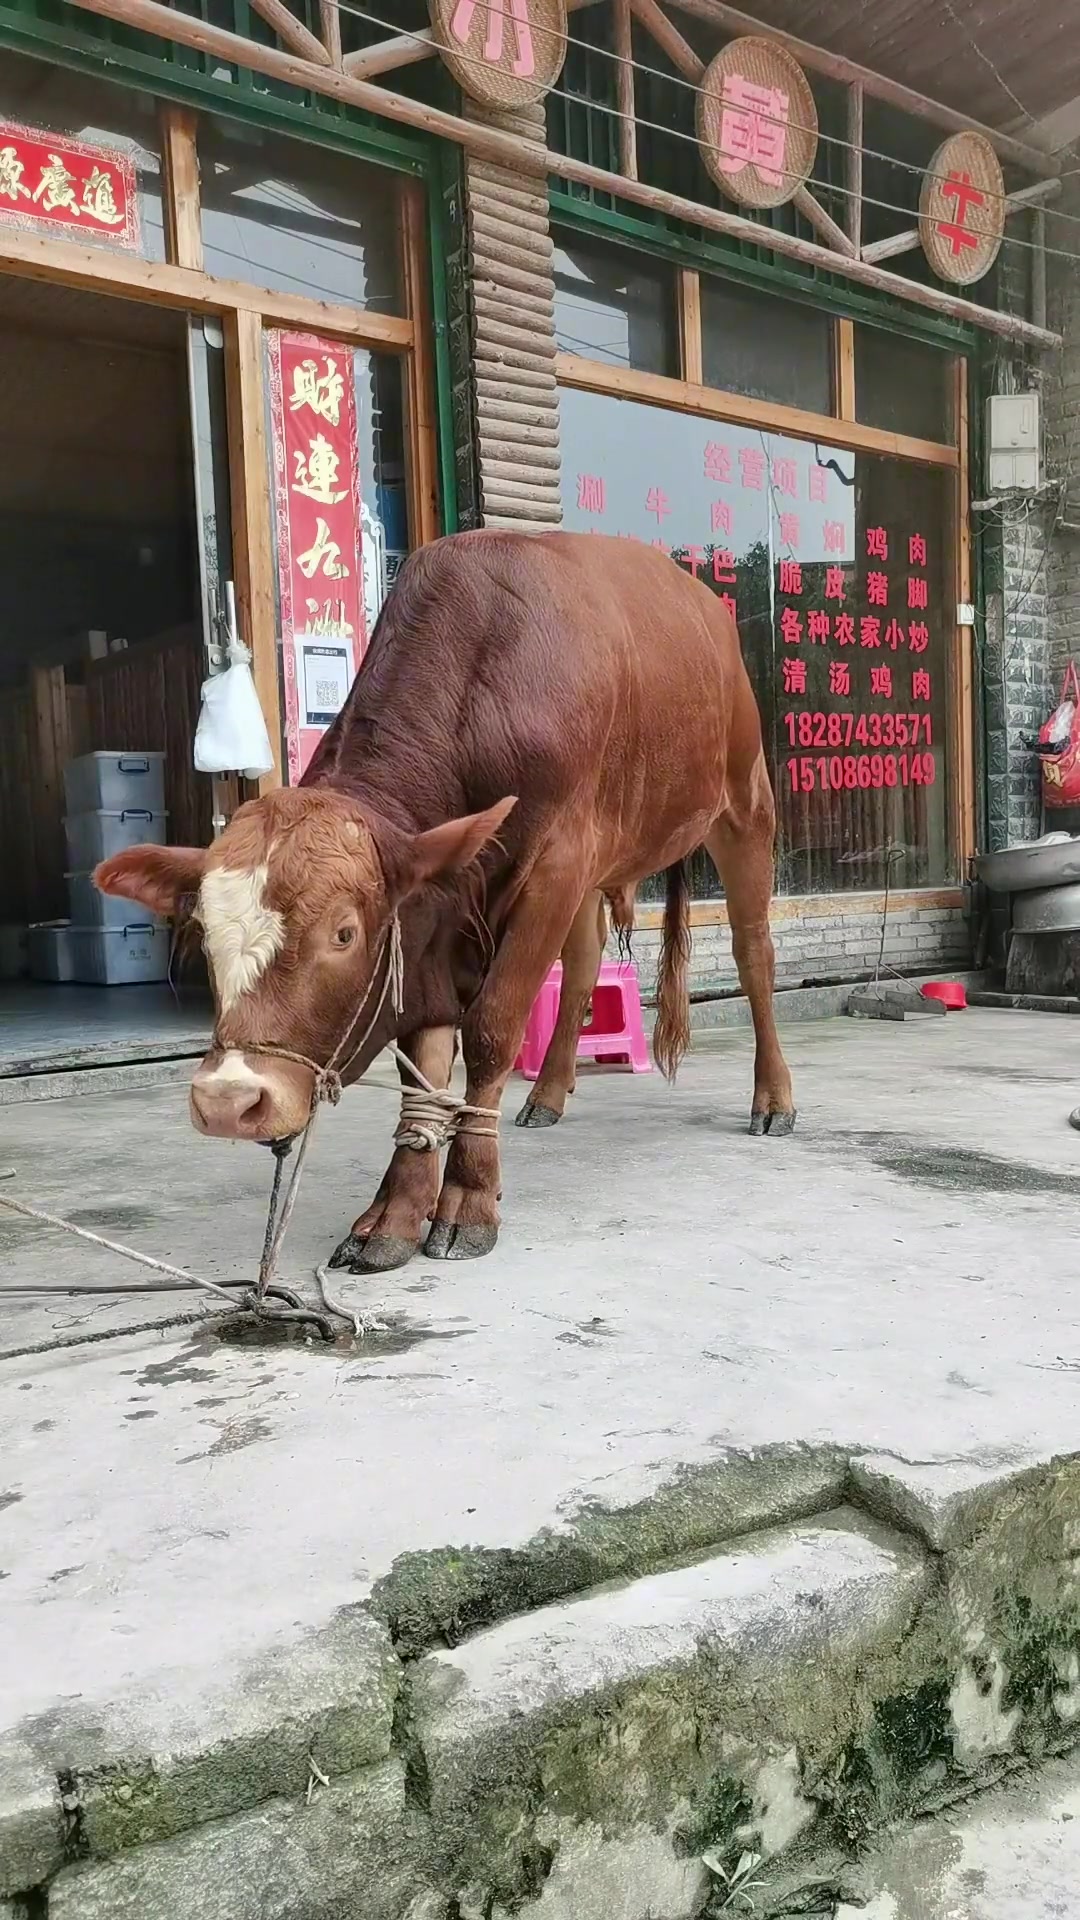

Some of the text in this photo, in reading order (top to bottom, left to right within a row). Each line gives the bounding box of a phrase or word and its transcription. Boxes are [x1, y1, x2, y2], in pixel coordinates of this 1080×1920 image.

[703, 439, 827, 503] 经营项目
[576, 472, 733, 536] 涮牛肉
[779, 511, 928, 567] 黄焖鸡肉
[779, 558, 928, 610] 脆皮猪脚
[780, 607, 929, 653] 各种农家小炒
[782, 656, 931, 701] 清汤鸡肉
[784, 711, 933, 747] 18287433571
[786, 751, 936, 793] 15108698149
